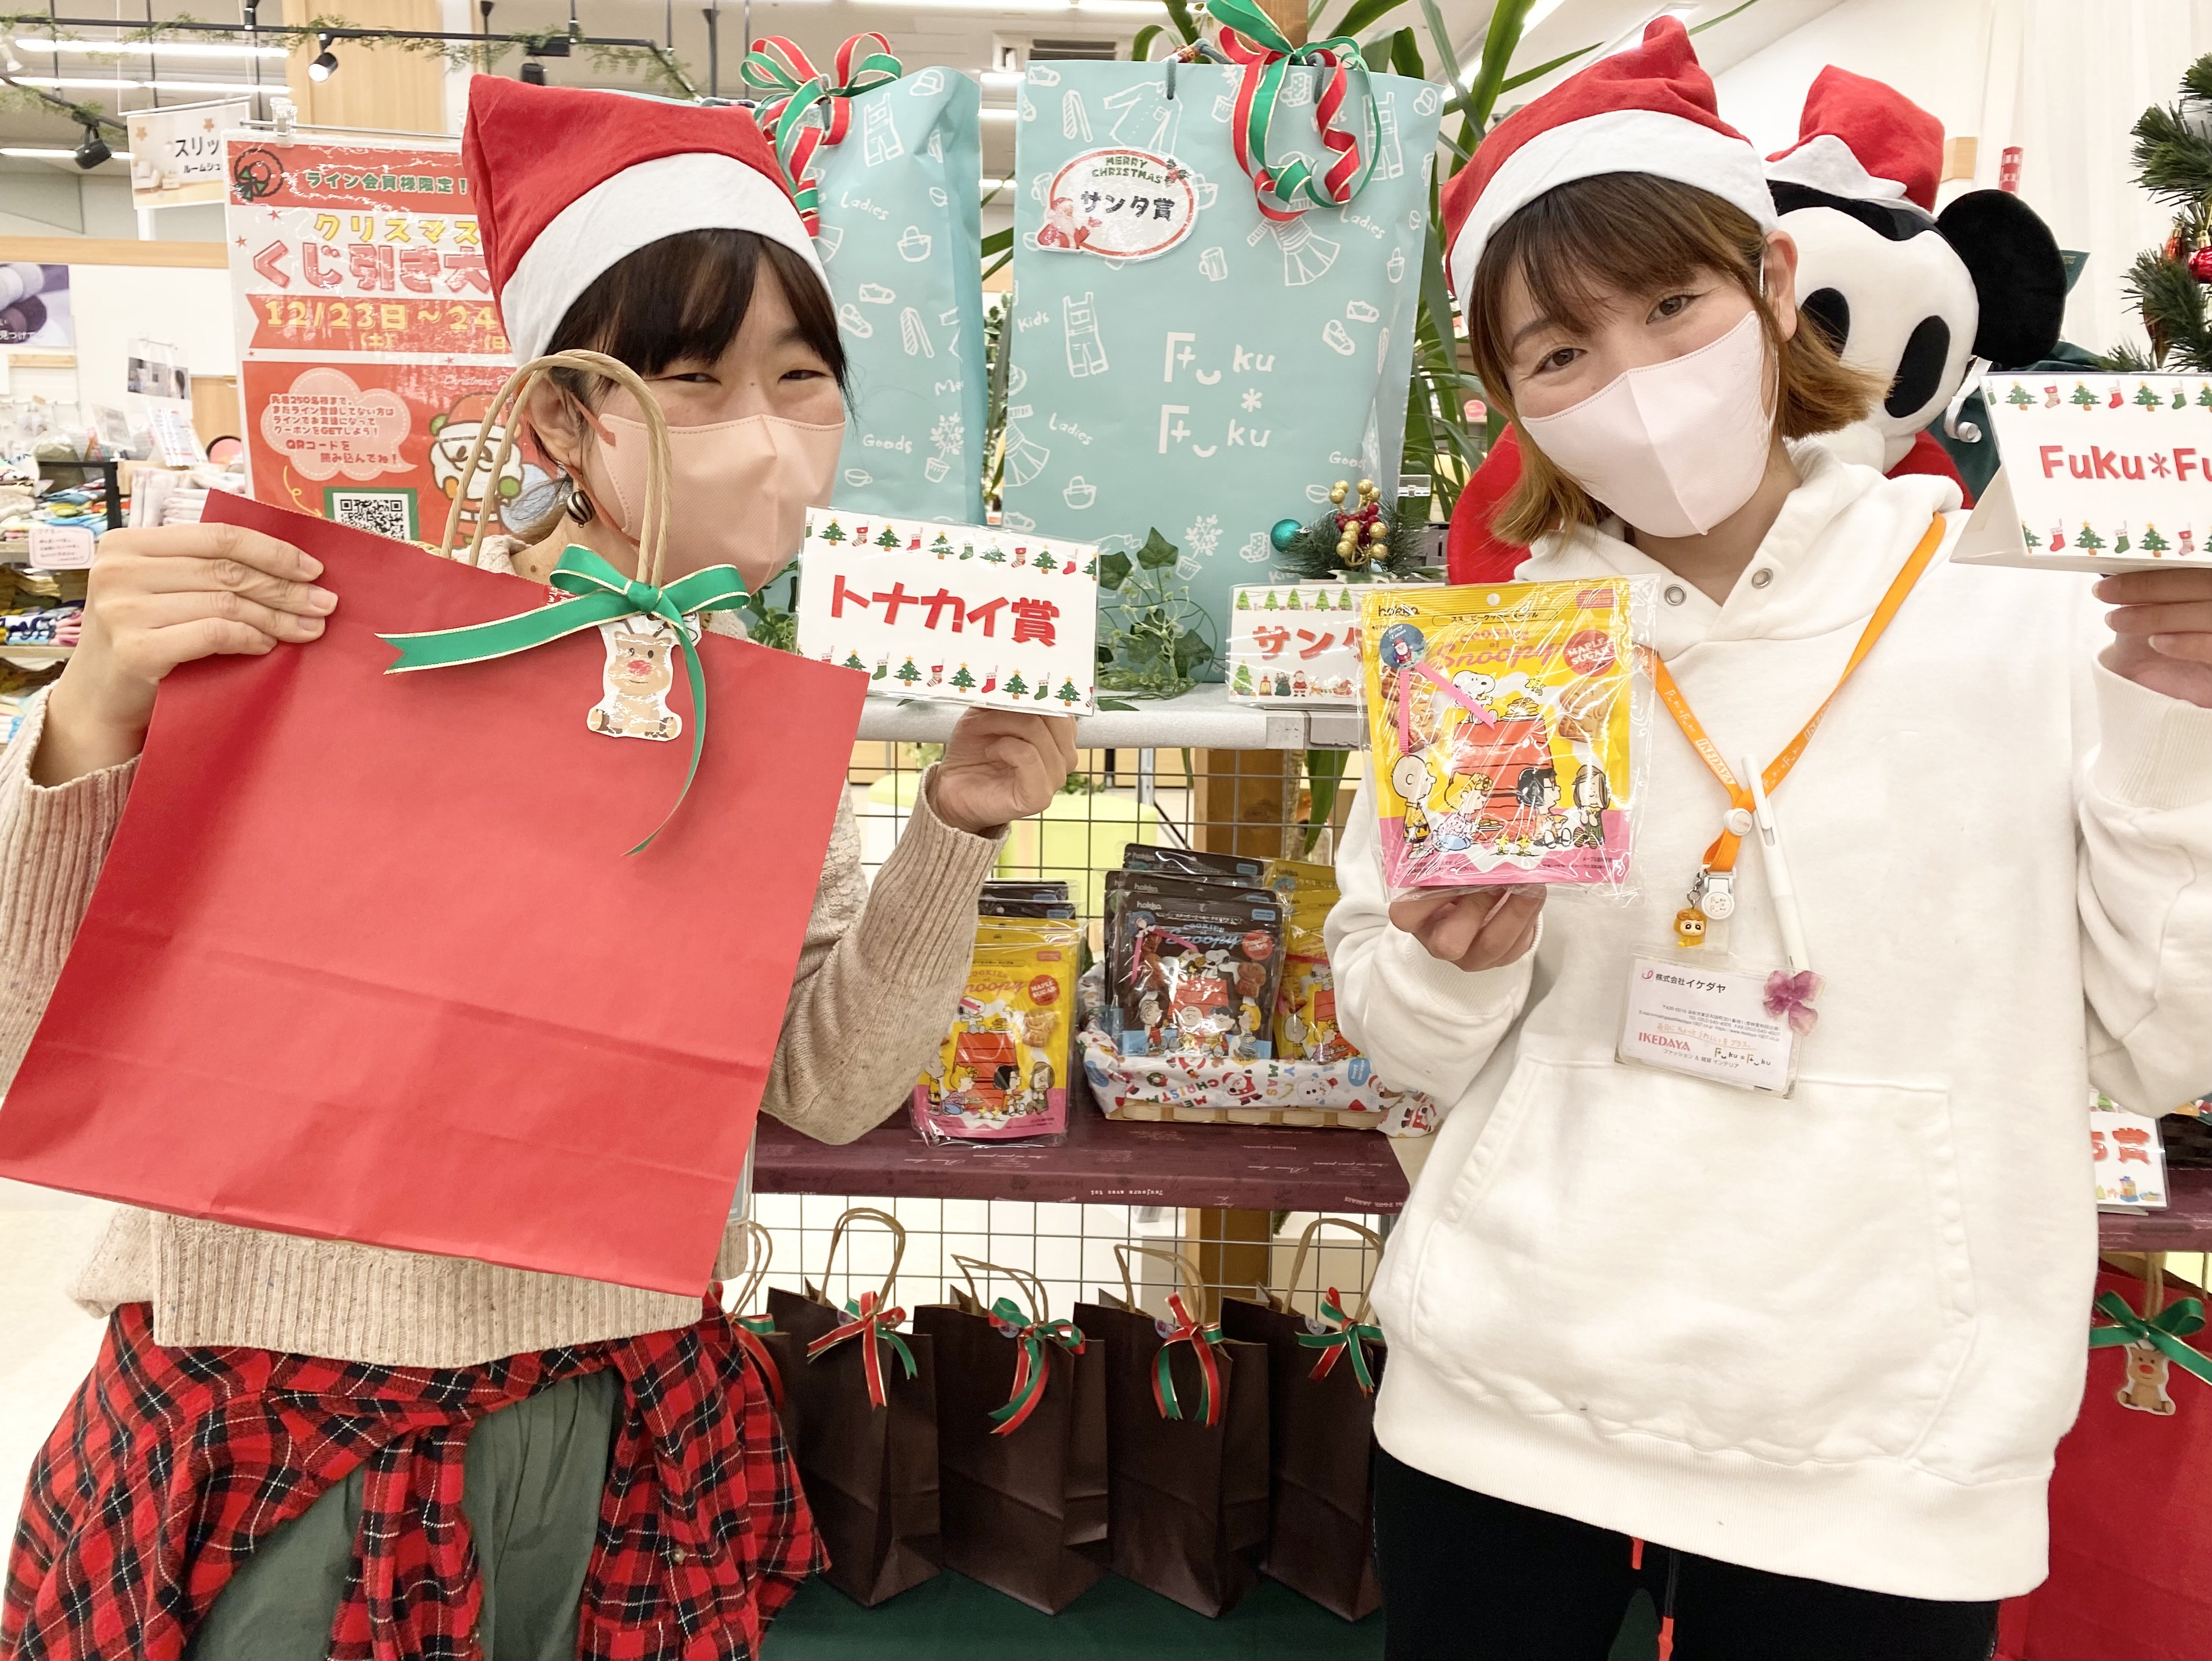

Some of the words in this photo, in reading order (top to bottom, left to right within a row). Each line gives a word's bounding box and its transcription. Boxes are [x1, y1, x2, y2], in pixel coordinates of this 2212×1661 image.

[175, 136, 220, 158] スリッ
[1105, 155, 1148, 169] MERRY
[305, 171, 468, 195] ライン会員様限定！
[1091, 168, 1164, 184] CHRISTMAS
[840, 190, 890, 221] Ladies
[1081, 190, 1176, 222] サンタ賞
[314, 212, 480, 245] クリスマス
[1339, 203, 1386, 240] Ladies
[1017, 310, 1050, 333] Kids
[1049, 411, 1094, 445] Ladies
[862, 433, 913, 454] Goods
[831, 574, 1060, 647] トナカイ賞
[1567, 637, 1606, 657] MAPLE
[1165, 928, 1243, 949] Soopy
[970, 969, 1008, 979] OOKIES
[1655, 973, 1727, 994] 株式会社イケダヤ
[1638, 1032, 1690, 1051] IKEDAYA
